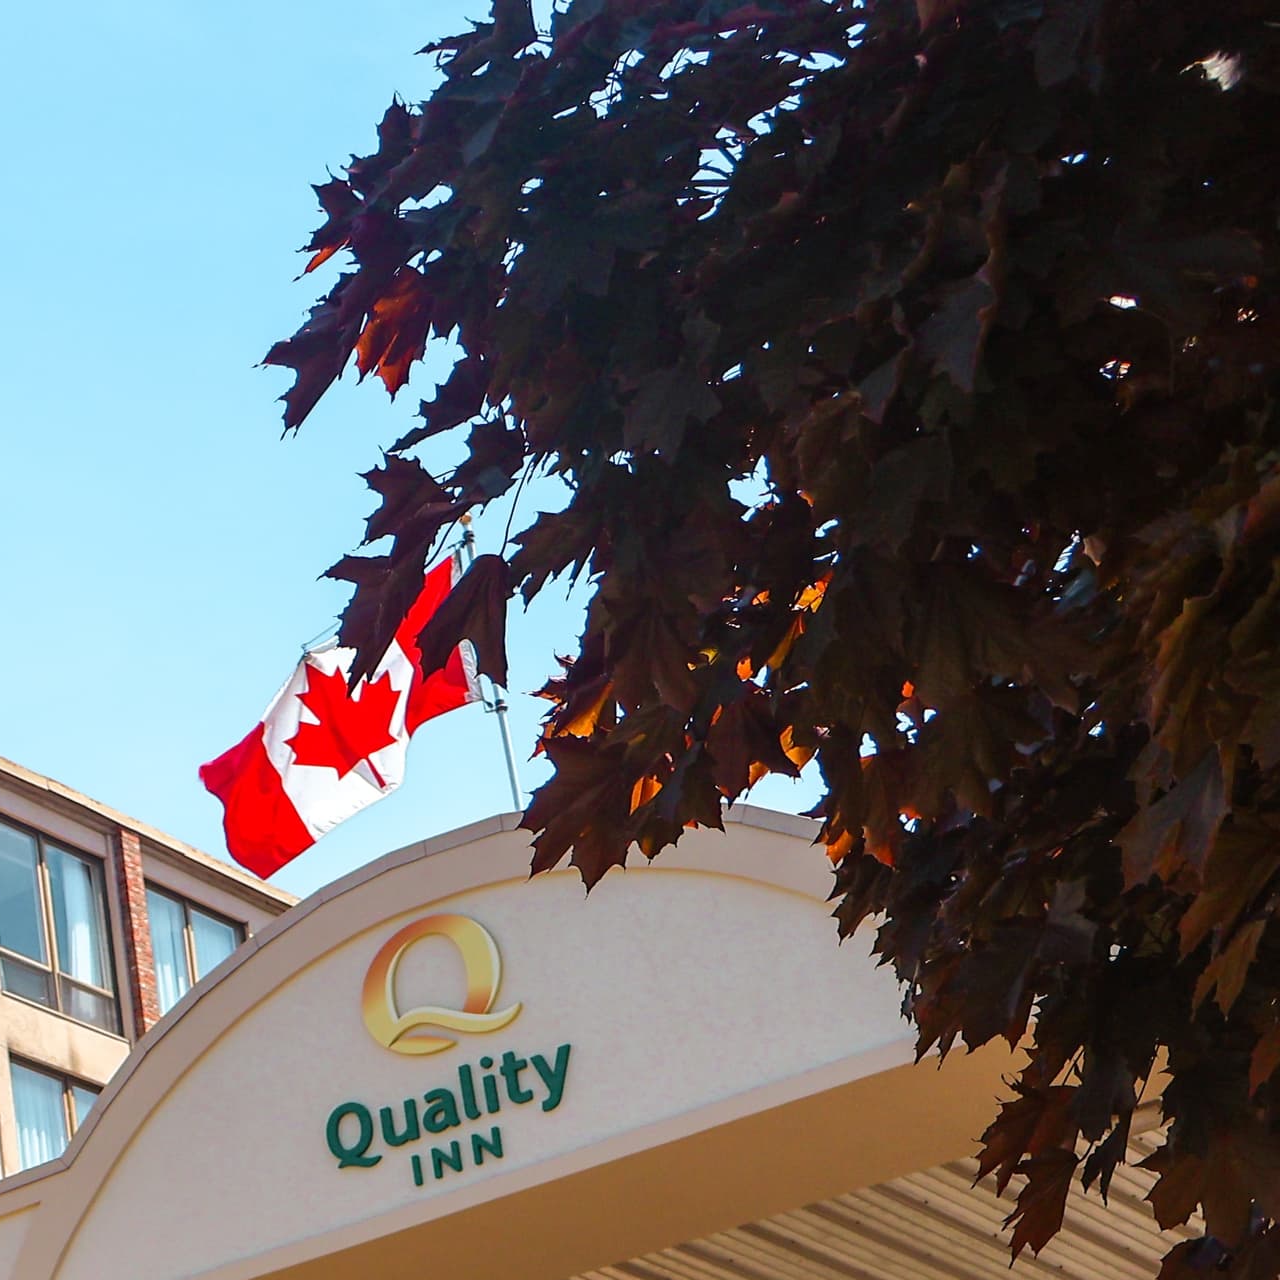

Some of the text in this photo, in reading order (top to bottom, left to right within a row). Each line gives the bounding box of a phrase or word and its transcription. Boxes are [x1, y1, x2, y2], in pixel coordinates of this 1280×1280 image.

[361, 913, 524, 1056] Q
[326, 1043, 571, 1169] Quality
[411, 1126, 504, 1187] INN
